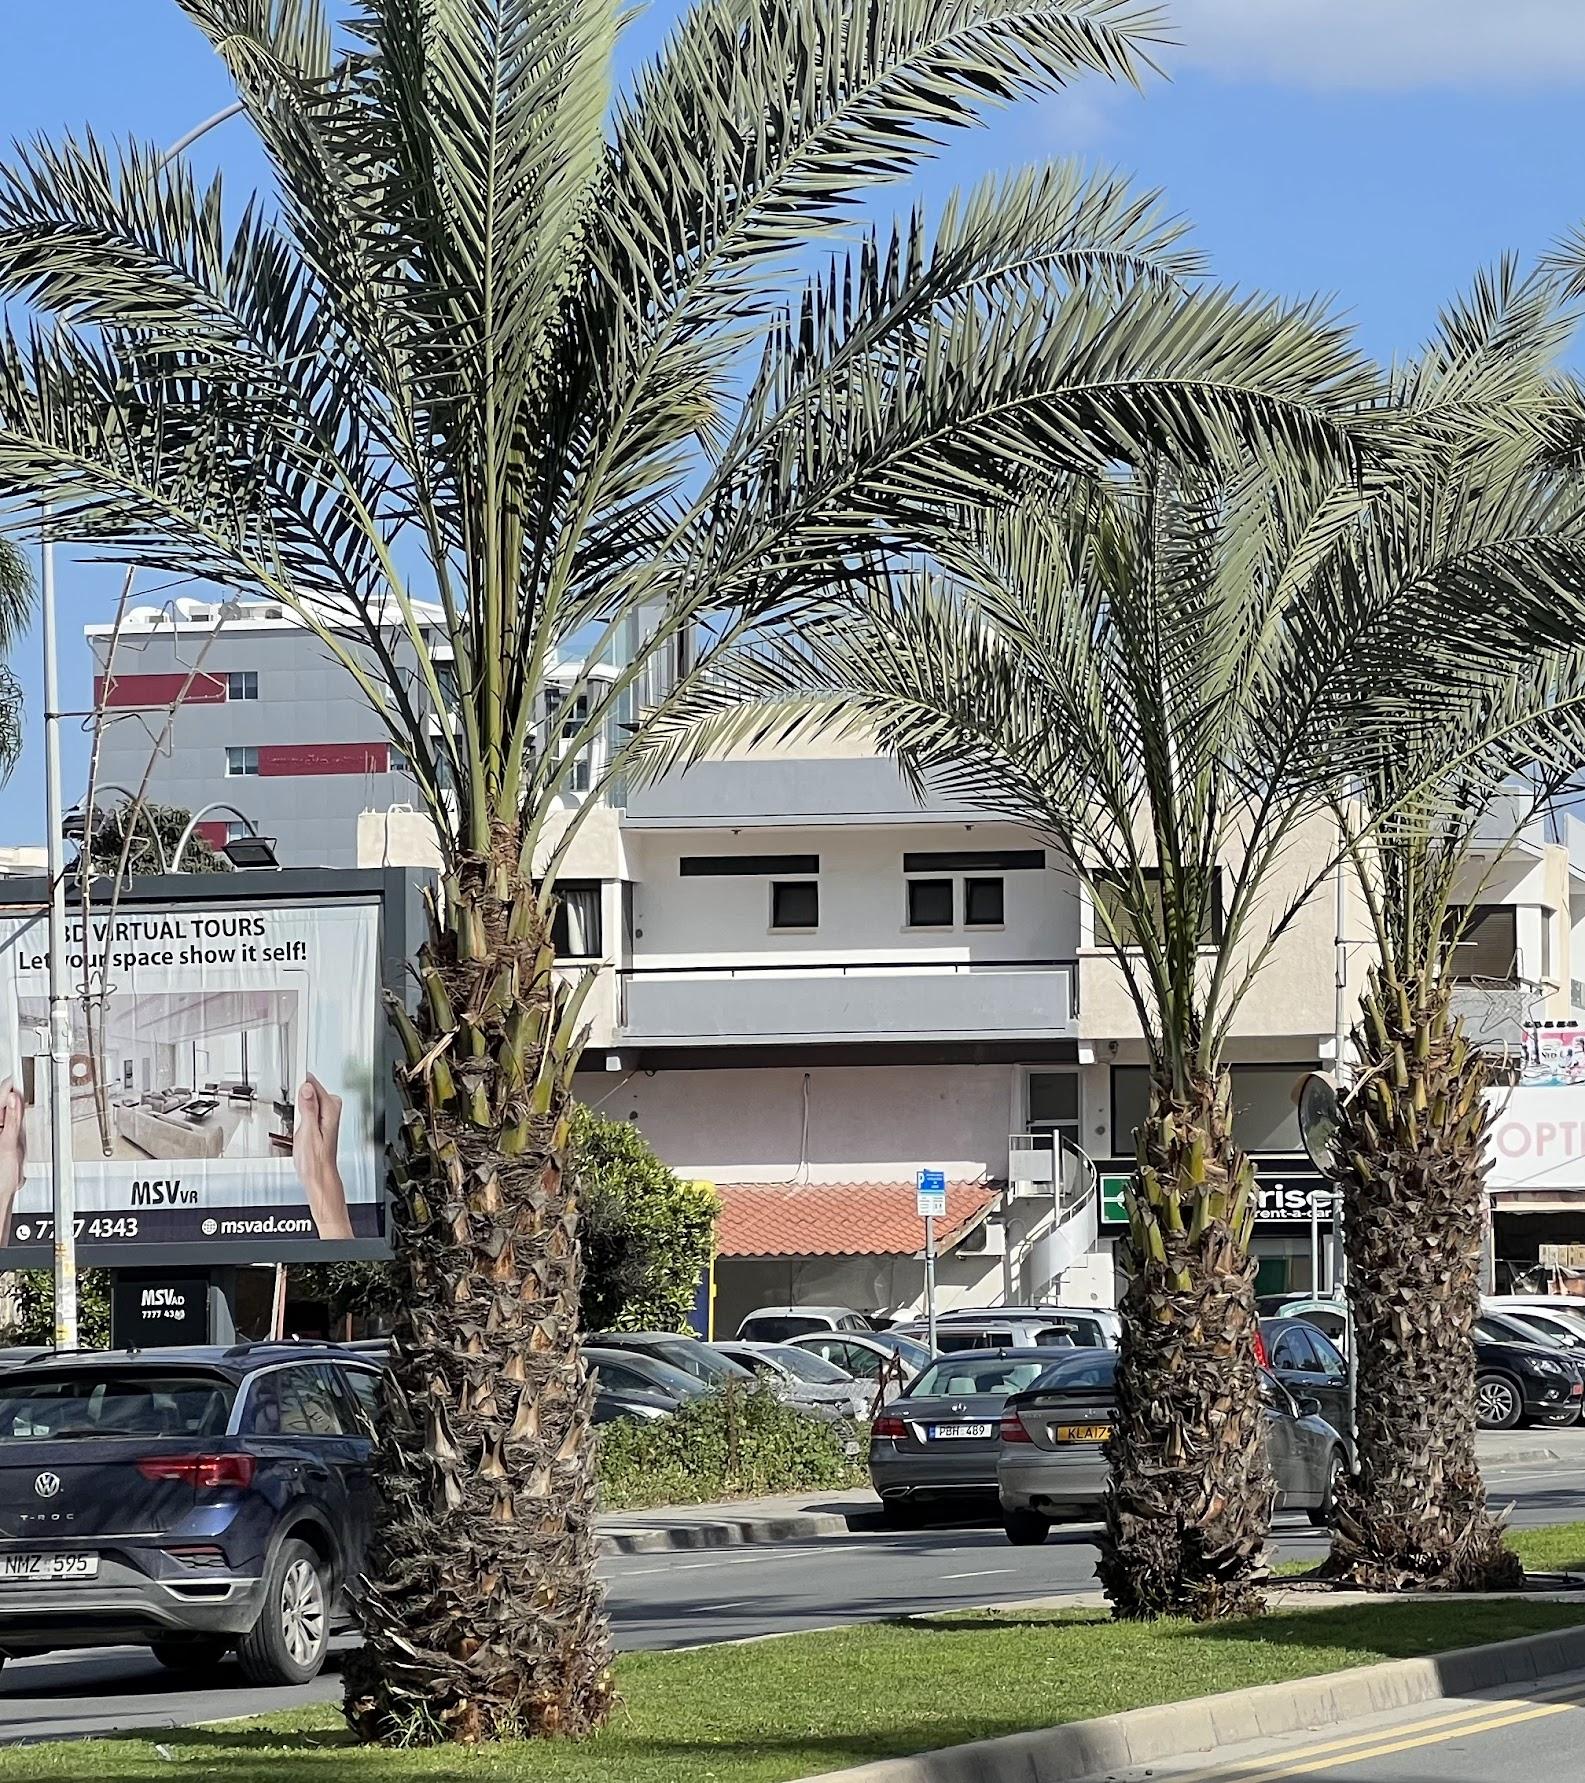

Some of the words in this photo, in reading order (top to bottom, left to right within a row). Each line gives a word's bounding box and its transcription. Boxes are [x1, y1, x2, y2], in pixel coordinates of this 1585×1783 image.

[191, 918, 266, 938] TOURS
[19, 951, 50, 970] Let
[113, 949, 173, 972] space
[179, 945, 235, 964] show
[242, 944, 257, 962] it
[262, 942, 307, 962] self!
[35, 1219, 85, 1240] 77
[88, 1217, 138, 1238] 4343
[221, 1216, 312, 1235] msvad.com
[142, 1310, 161, 1319] 7777
[5, 1554, 42, 1574] NMZ
[53, 1554, 88, 1572] 595
